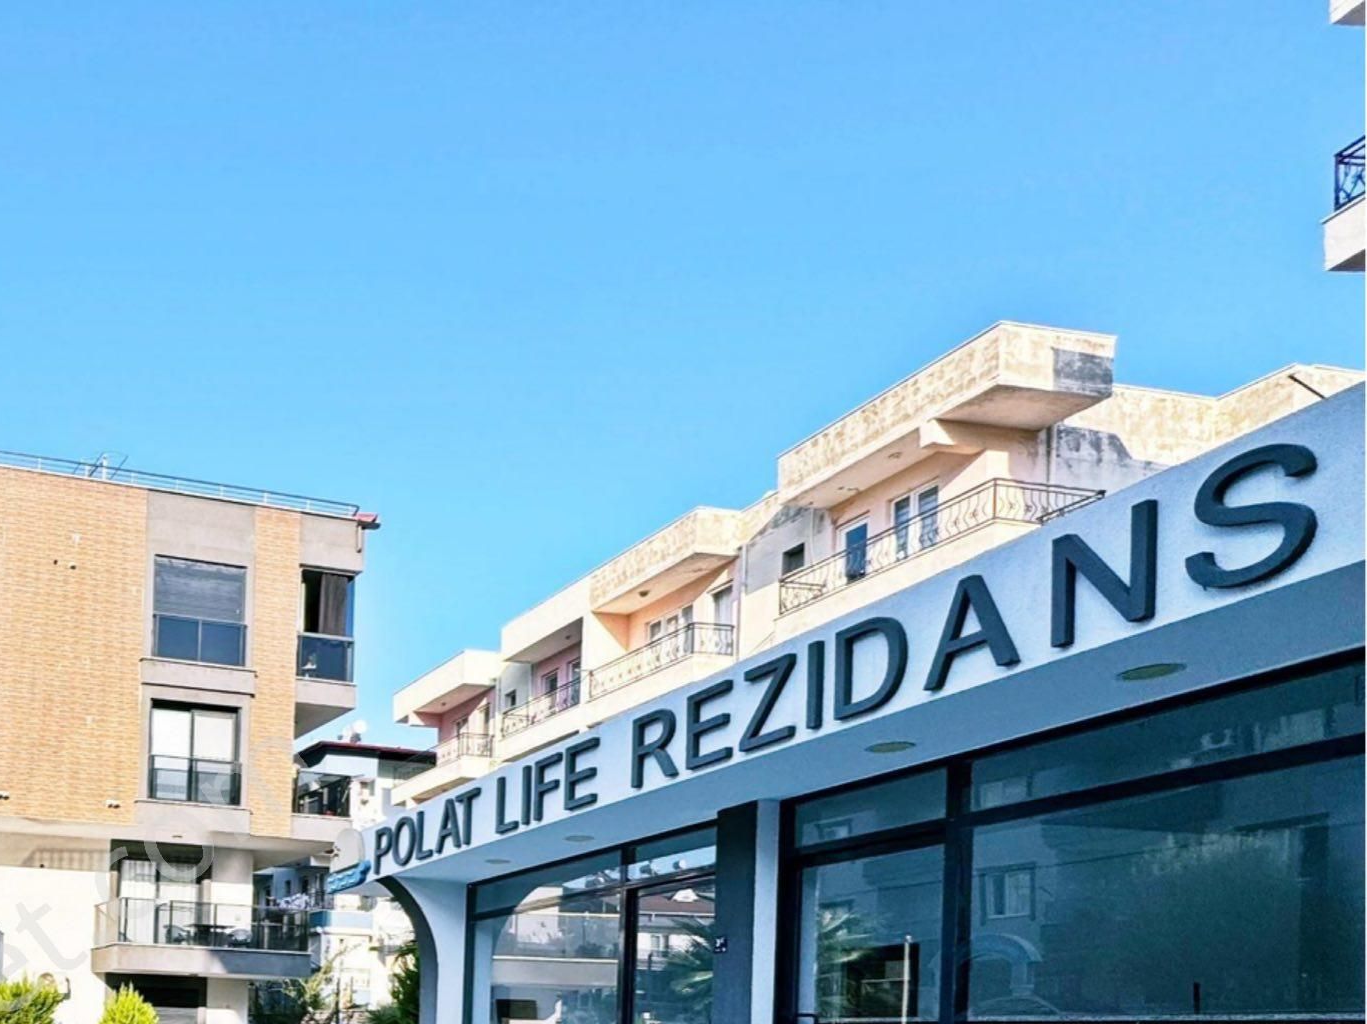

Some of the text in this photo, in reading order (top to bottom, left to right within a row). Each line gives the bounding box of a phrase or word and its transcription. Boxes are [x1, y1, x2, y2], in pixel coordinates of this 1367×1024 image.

[373, 442, 1318, 875] POLAT LIFE REZIDANS
